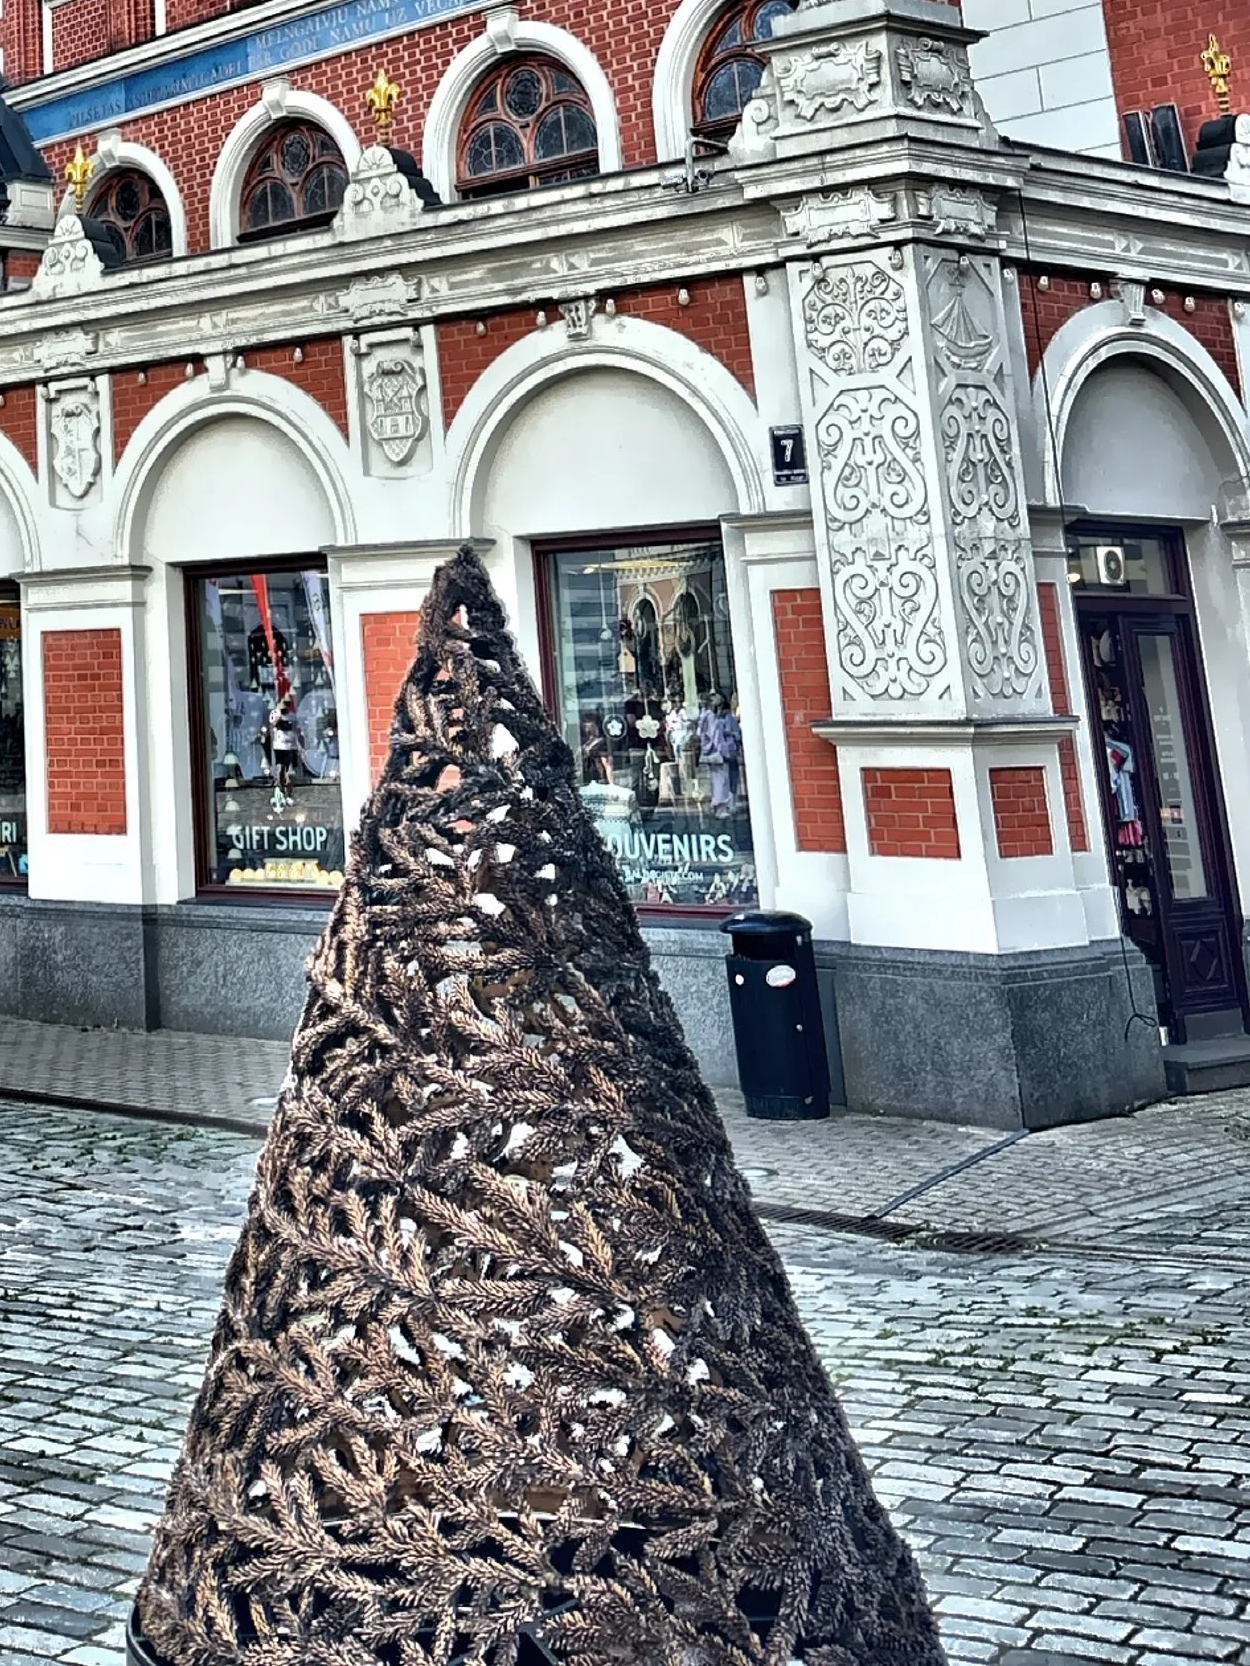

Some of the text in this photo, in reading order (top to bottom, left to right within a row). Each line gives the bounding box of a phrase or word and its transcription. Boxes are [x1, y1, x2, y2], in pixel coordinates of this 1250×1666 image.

[331, 18, 375, 44] NAMU
[385, 8, 408, 25] UZ
[781, 439, 793, 462] 7
[232, 826, 327, 851] GIFT SHOP
[607, 833, 734, 863] OUVENIRS
